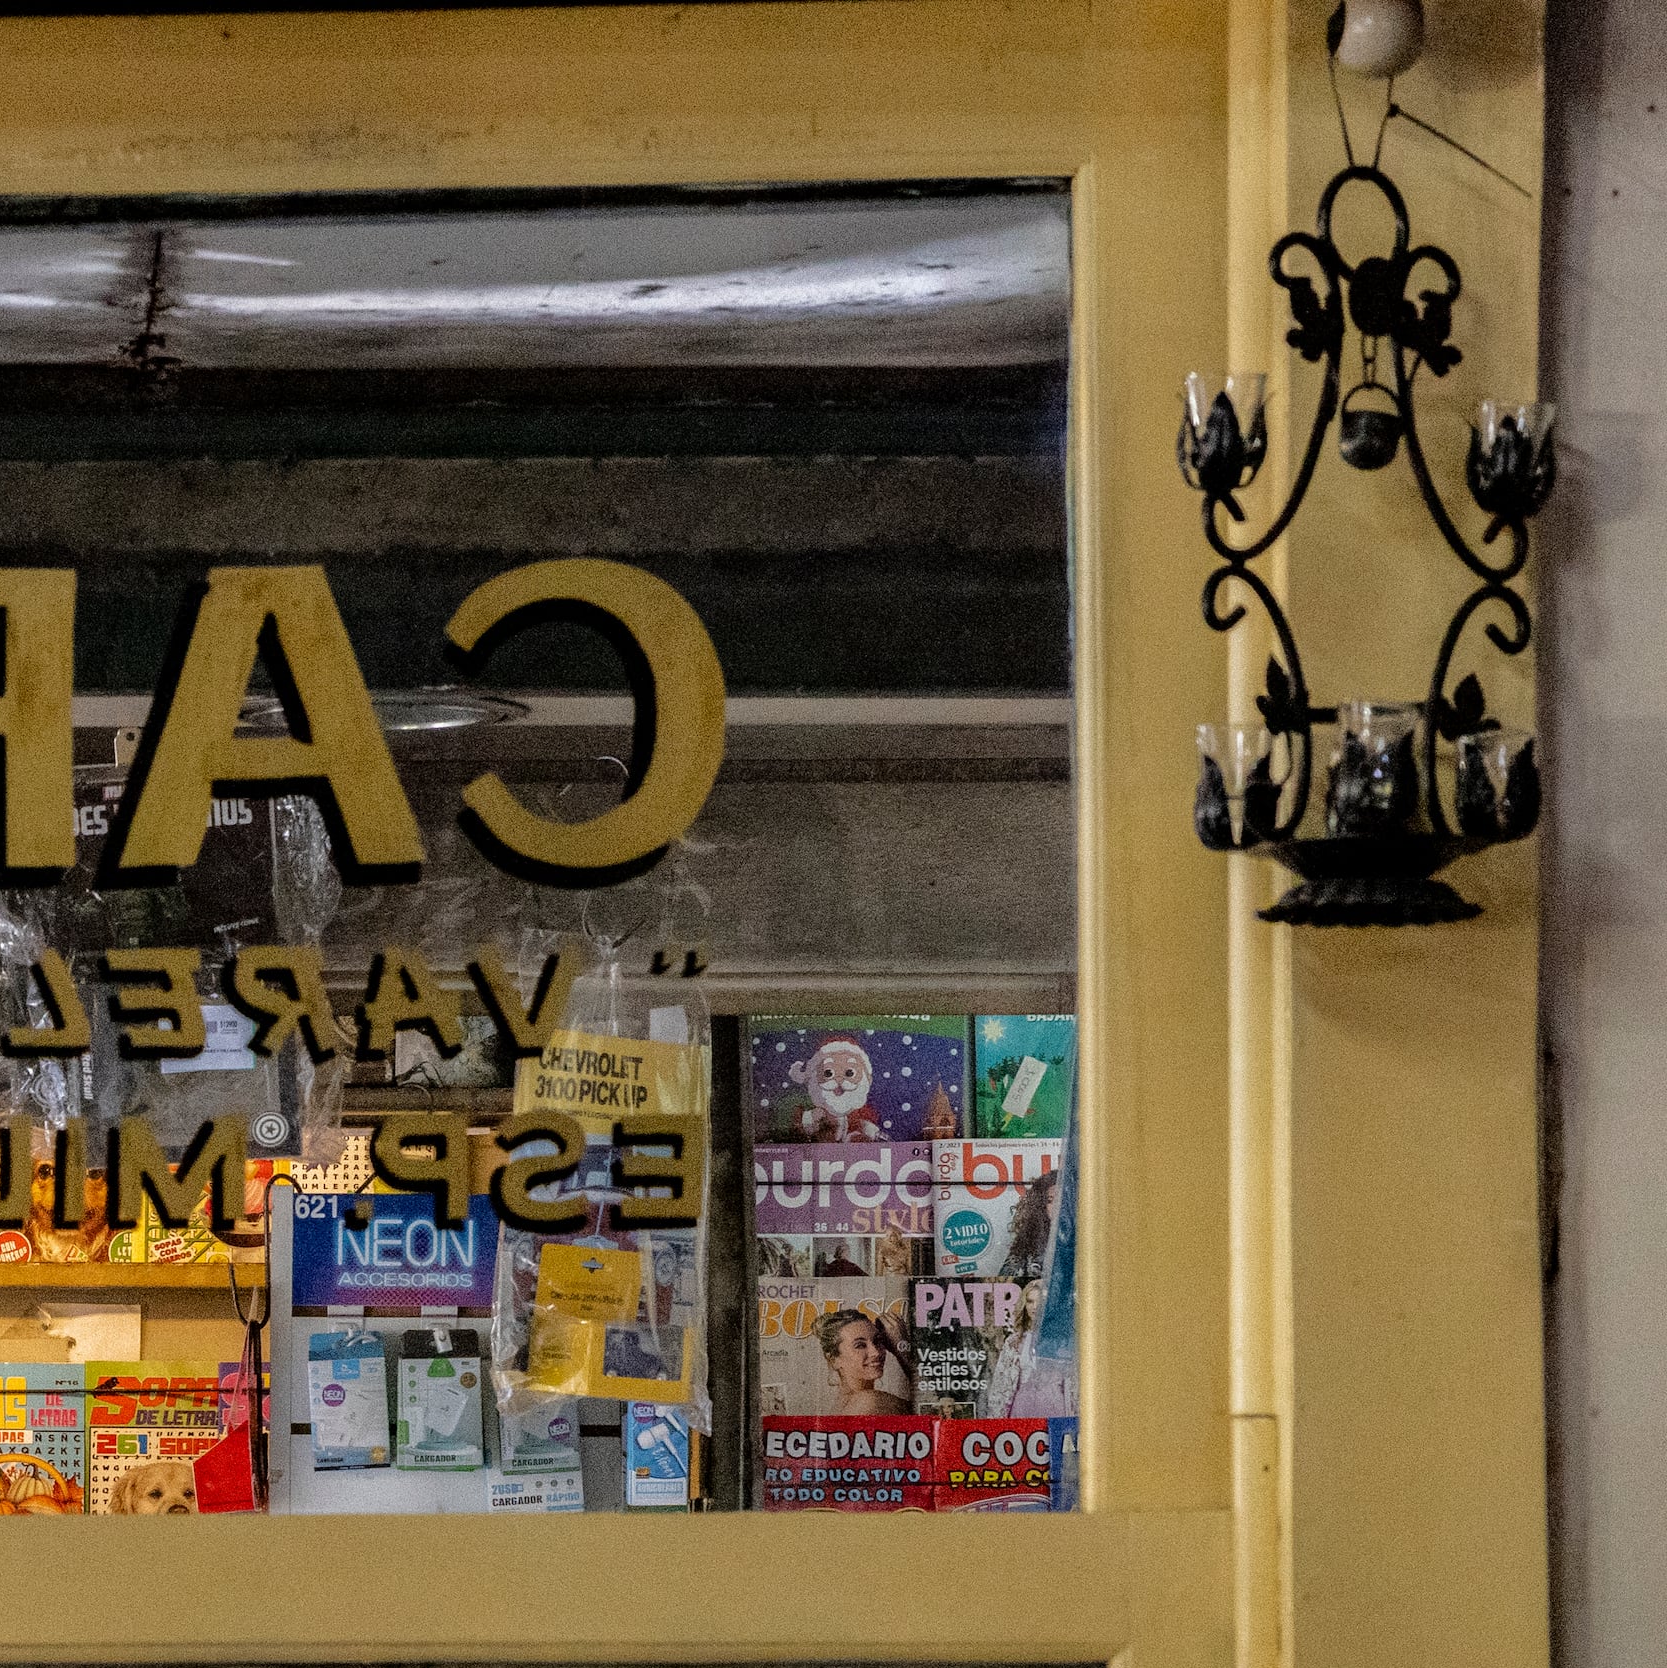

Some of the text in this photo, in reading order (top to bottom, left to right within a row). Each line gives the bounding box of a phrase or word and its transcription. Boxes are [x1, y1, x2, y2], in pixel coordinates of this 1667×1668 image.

[540, 1047, 643, 1081] CHEVROLET
[535, 1078, 577, 1100] 3100
[579, 1082, 620, 1107] PICK
[294, 1195, 339, 1220] 621
[337, 1218, 475, 1268] NEON
[338, 1272, 473, 1288] ACCESORIOS
[918, 1348, 986, 1361] Vestidos
[918, 1361, 982, 1377] fáciles y
[917, 1377, 988, 1392] estilosos
[45, 1393, 63, 1406] DE
[30, 1408, 77, 1427] LETRAS
[766, 1431, 931, 1460] ECEDARIO
[414, 1455, 456, 1463] CARGADOR
[511, 1457, 554, 1466] CARGADOR
[771, 1486, 904, 1502] TODO COLOR
